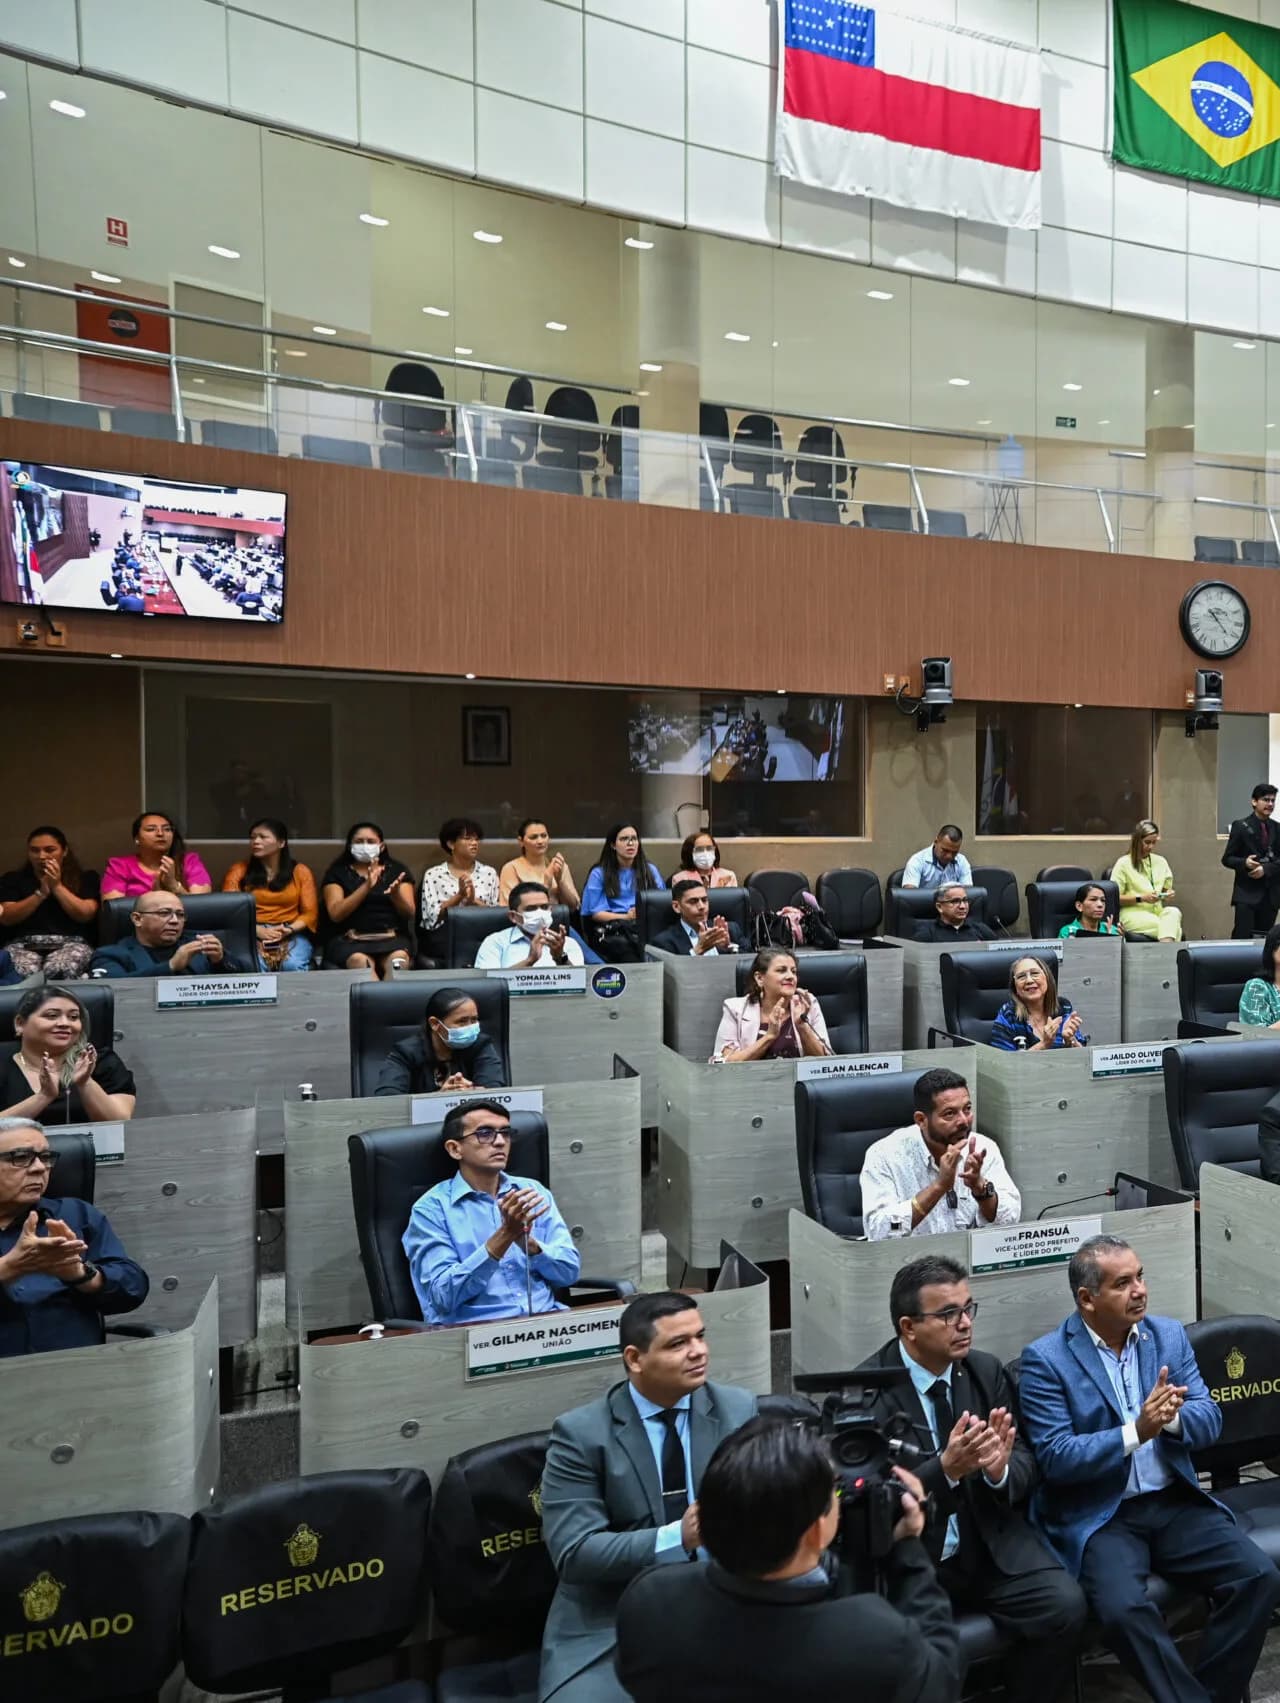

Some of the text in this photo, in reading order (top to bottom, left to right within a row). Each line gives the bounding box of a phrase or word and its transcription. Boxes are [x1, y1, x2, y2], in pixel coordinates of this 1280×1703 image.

[515, 973, 572, 982] YOMARA LINS
[191, 982, 231, 992] THAYSA
[232, 981, 261, 990] LIPPY
[1110, 1052, 1137, 1061] JAILDO
[1137, 1050, 1162, 1058] OLIVEI
[822, 1065, 846, 1074] ELAN
[847, 1062, 890, 1072] ALENCAR
[1018, 1224, 1070, 1241] FRANSUÁ
[1047, 1236, 1080, 1247] PREFEITO
[492, 1330, 546, 1347] GILMAR
[548, 1319, 621, 1338] NASCIMEN
[542, 1338, 572, 1349] UNIÃO
[220, 1558, 385, 1616] RESERVADO
[0, 1612, 134, 1657] ERVADO
